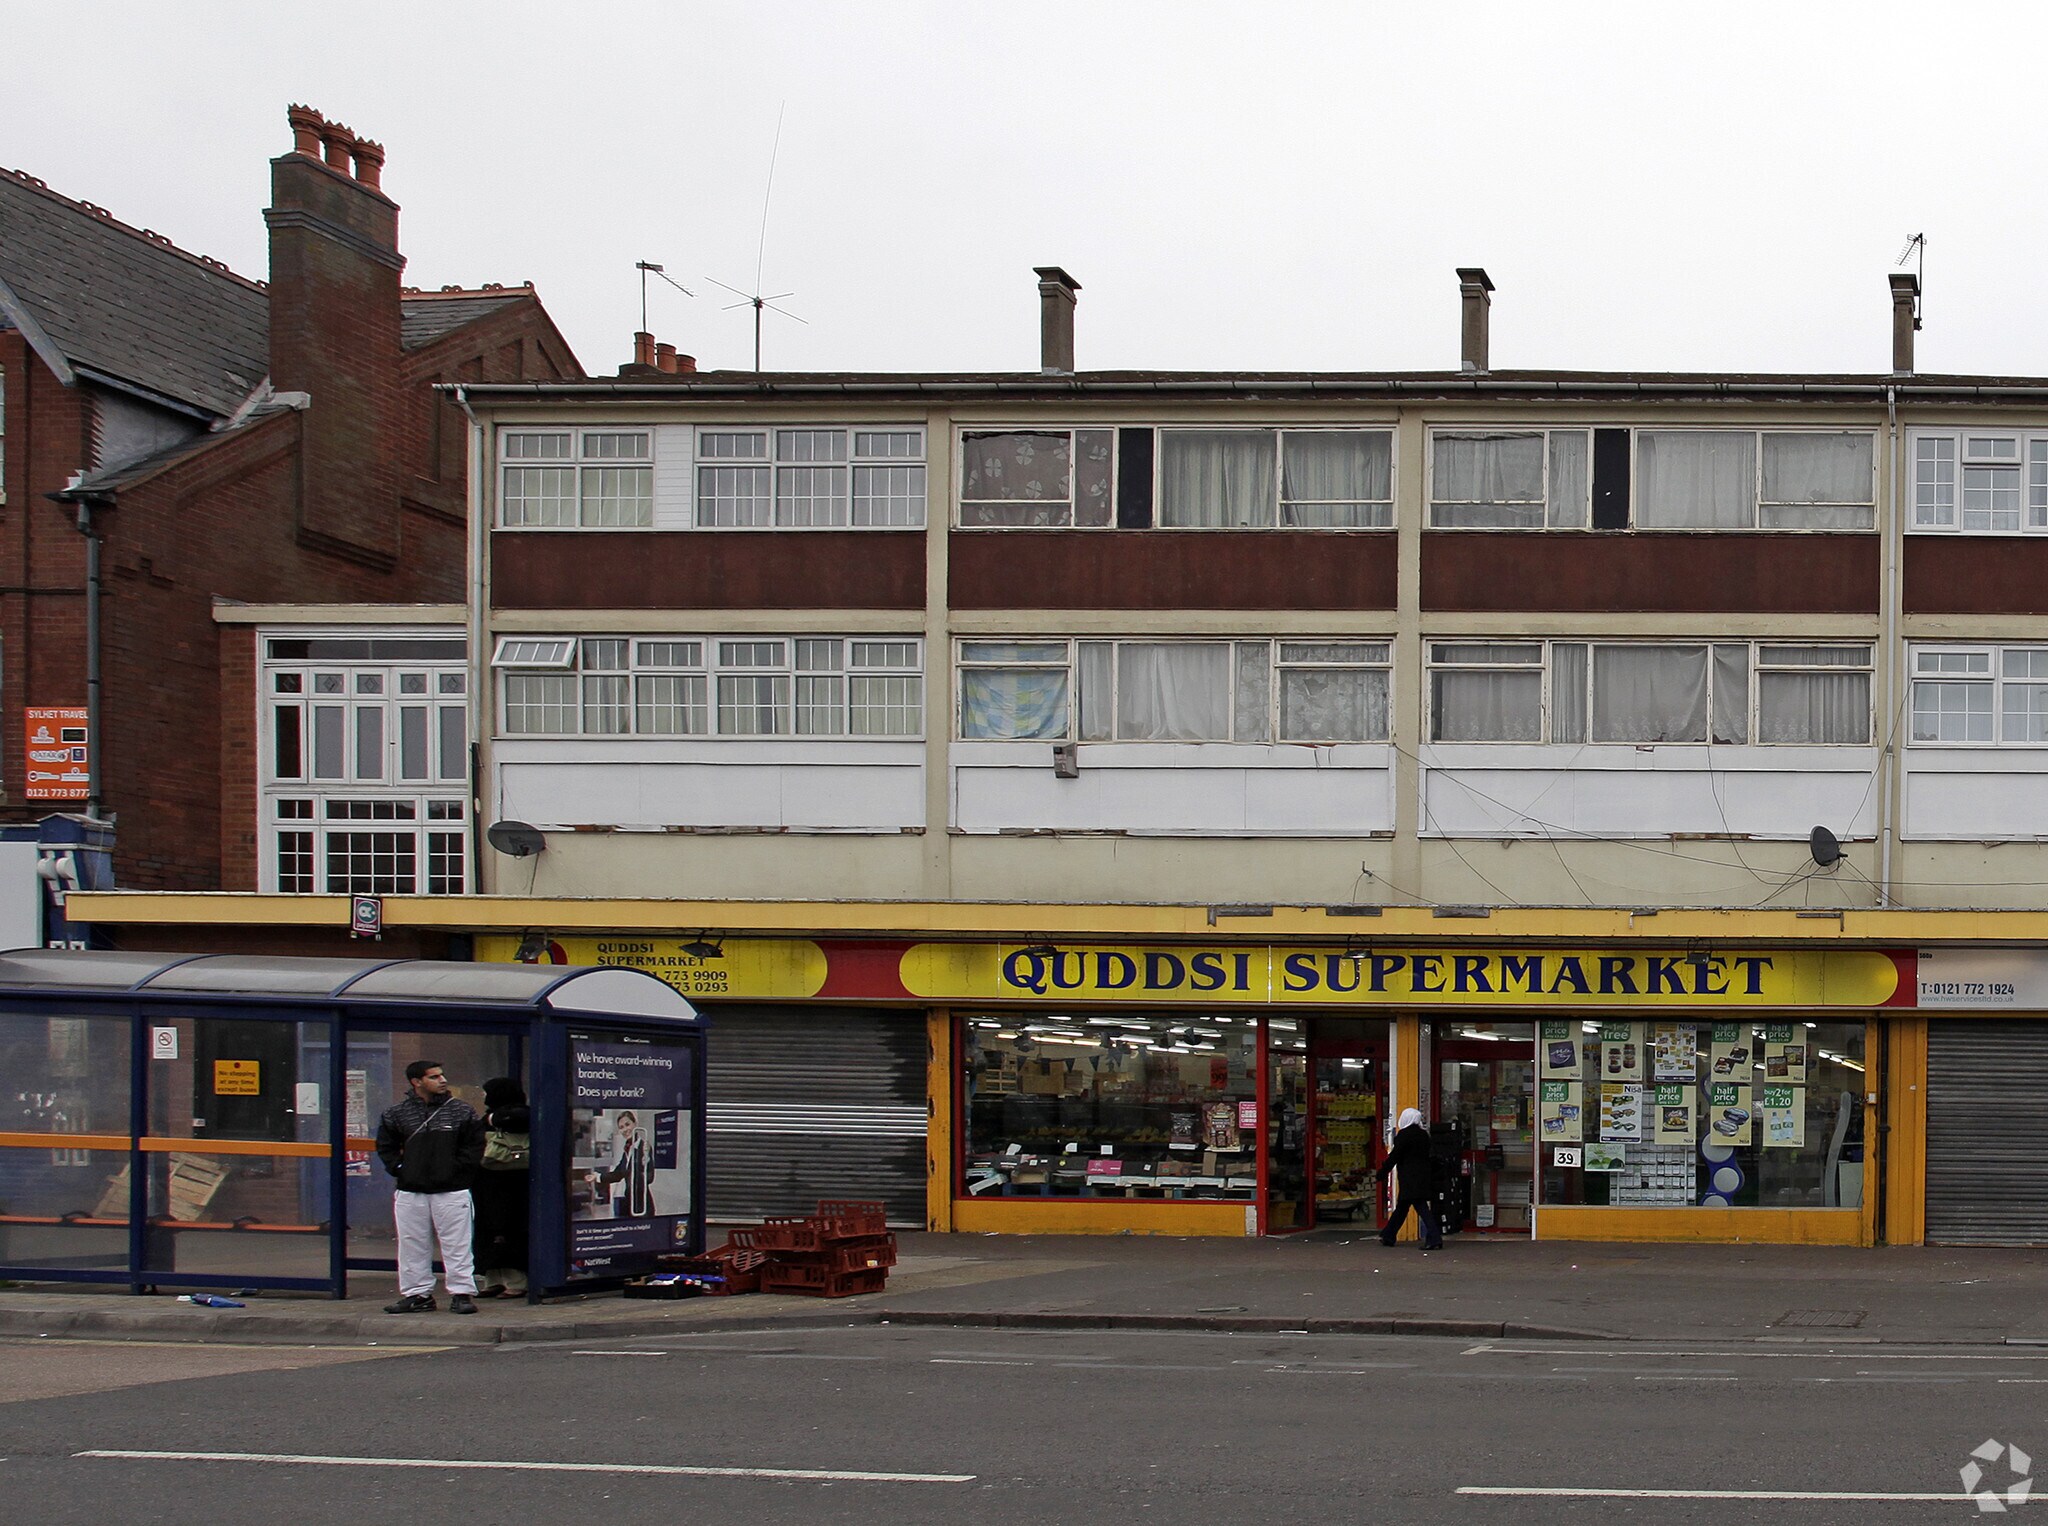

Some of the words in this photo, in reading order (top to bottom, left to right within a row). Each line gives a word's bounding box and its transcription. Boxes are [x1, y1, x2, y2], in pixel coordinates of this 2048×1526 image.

[28, 710, 58, 719] SYLHET
[26, 788, 49, 797] 0121
[51, 788, 68, 797] 773
[597, 943, 654, 954] QUDDSI
[597, 956, 706, 967] SUPERMARKET
[664, 971, 689, 981] 773
[693, 971, 727, 981] 9909
[1003, 949, 1251, 994] QUDDSI
[1283, 953, 1774, 995] SUPERMARKET
[695, 982, 728, 992] 0293
[1964, 983, 1984, 995] 772
[1988, 983, 2015, 995] 1924
[1545, 1027, 1567, 1035] price
[1678, 1023, 1696, 1031] Nisa
[1603, 1030, 1629, 1040] free
[1714, 1030, 1737, 1038] price
[1768, 1031, 1790, 1039] price
[577, 1052, 591, 1063] We
[592, 1053, 614, 1064] have
[614, 1055, 673, 1070] award-winning
[578, 1067, 618, 1080] branches.
[577, 1085, 600, 1097] Does
[601, 1089, 619, 1100] your
[620, 1087, 645, 1098] bank?
[1661, 1086, 1677, 1094] half
[1716, 1086, 1733, 1094] half
[1658, 1093, 1680, 1101] price
[1714, 1094, 1736, 1102] price
[1764, 1098, 1791, 1106] £1.20
[1557, 1152, 1574, 1165] 39
[584, 1257, 612, 1267] NatWest
